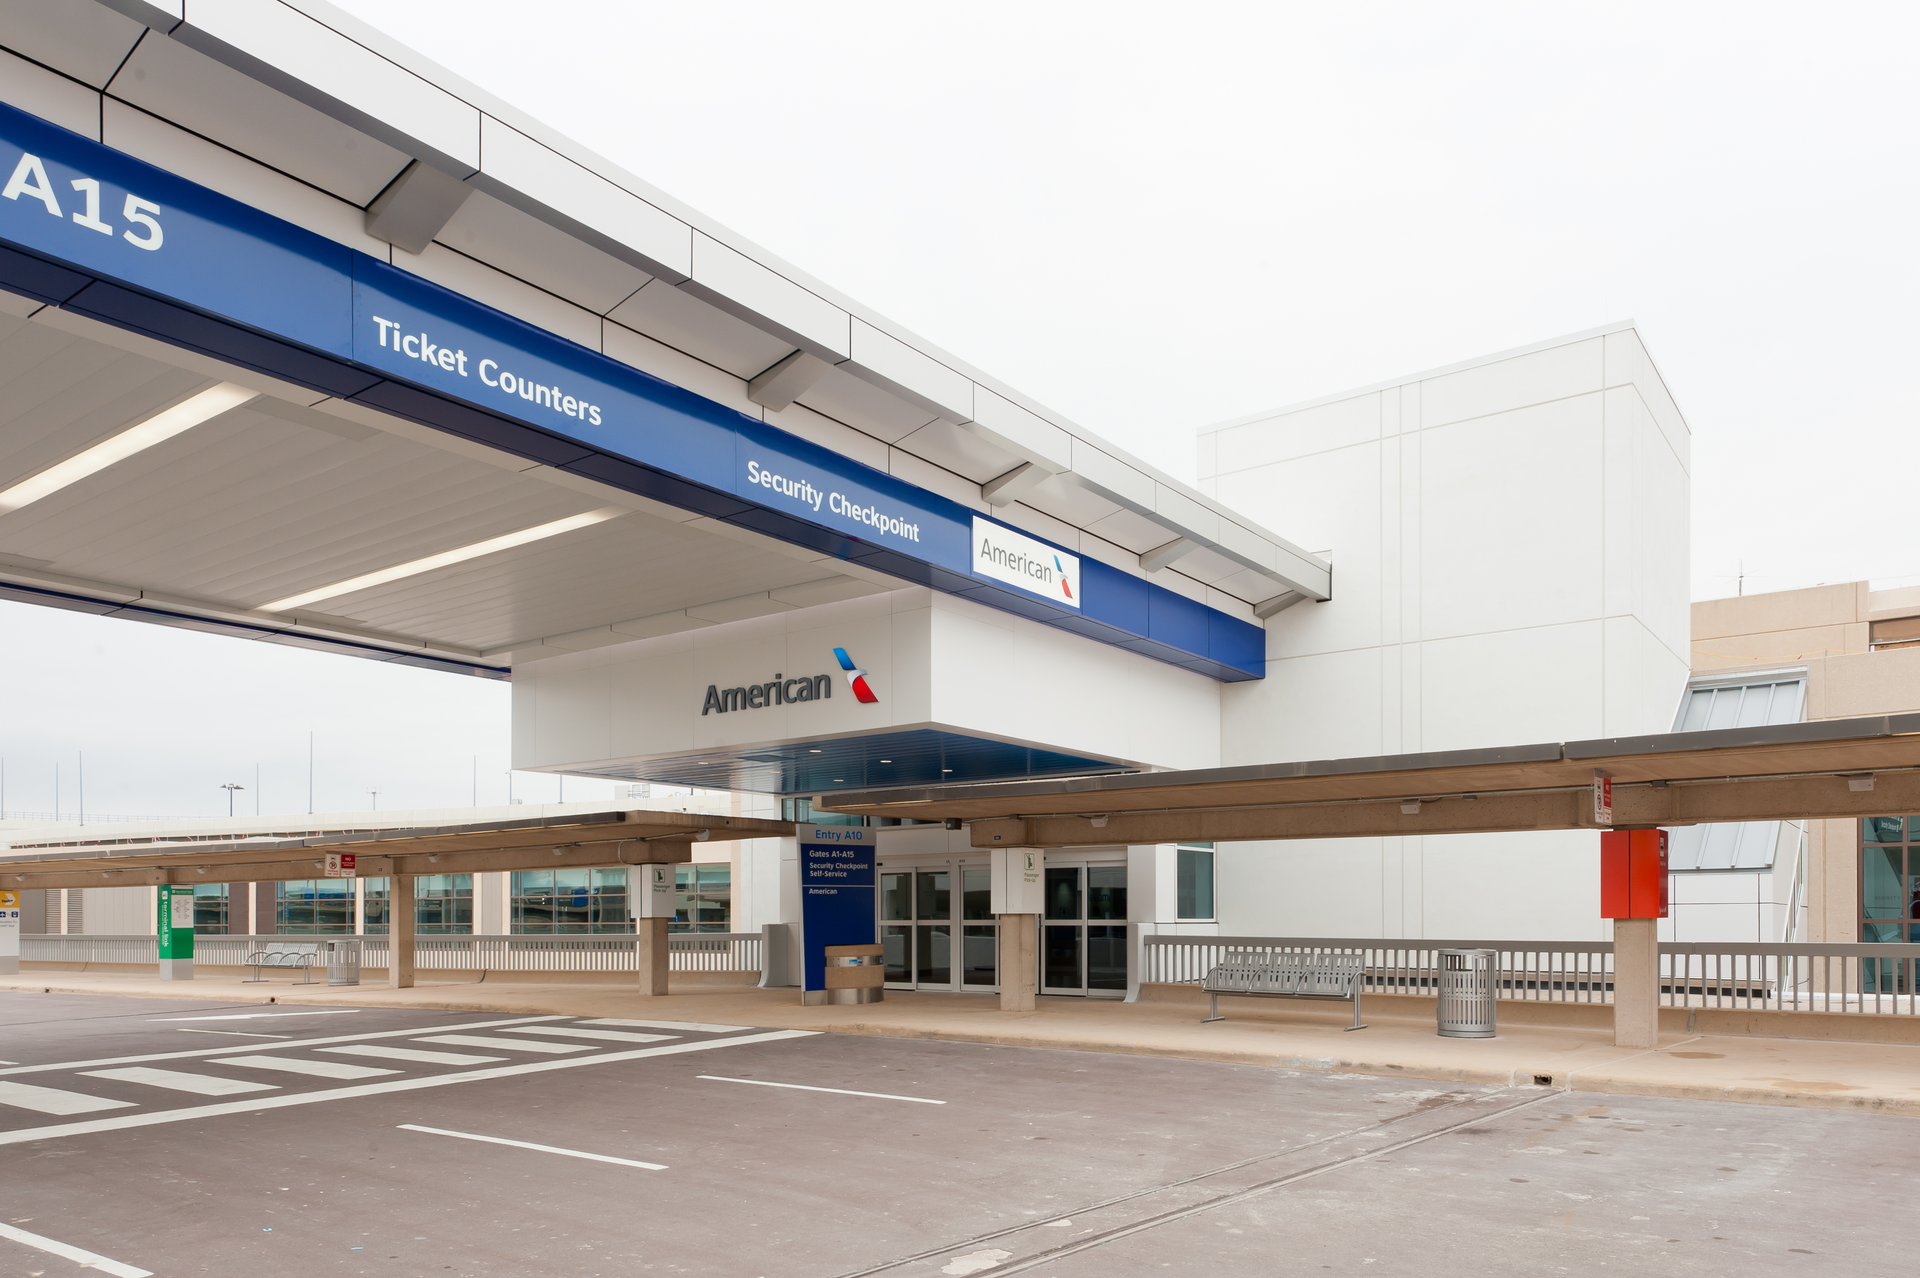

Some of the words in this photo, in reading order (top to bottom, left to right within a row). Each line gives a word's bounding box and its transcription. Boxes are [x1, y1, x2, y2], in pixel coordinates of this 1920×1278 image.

[2, 152, 164, 252] A15
[372, 315, 469, 378] Ticket
[479, 358, 602, 427] Counters
[747, 460, 823, 512] Security
[829, 492, 920, 543] Checkpoint
[980, 537, 1053, 584] American
[701, 673, 832, 716] American
[815, 830, 842, 842] Entry
[844, 830, 863, 841] A10
[809, 862, 834, 870] Security
